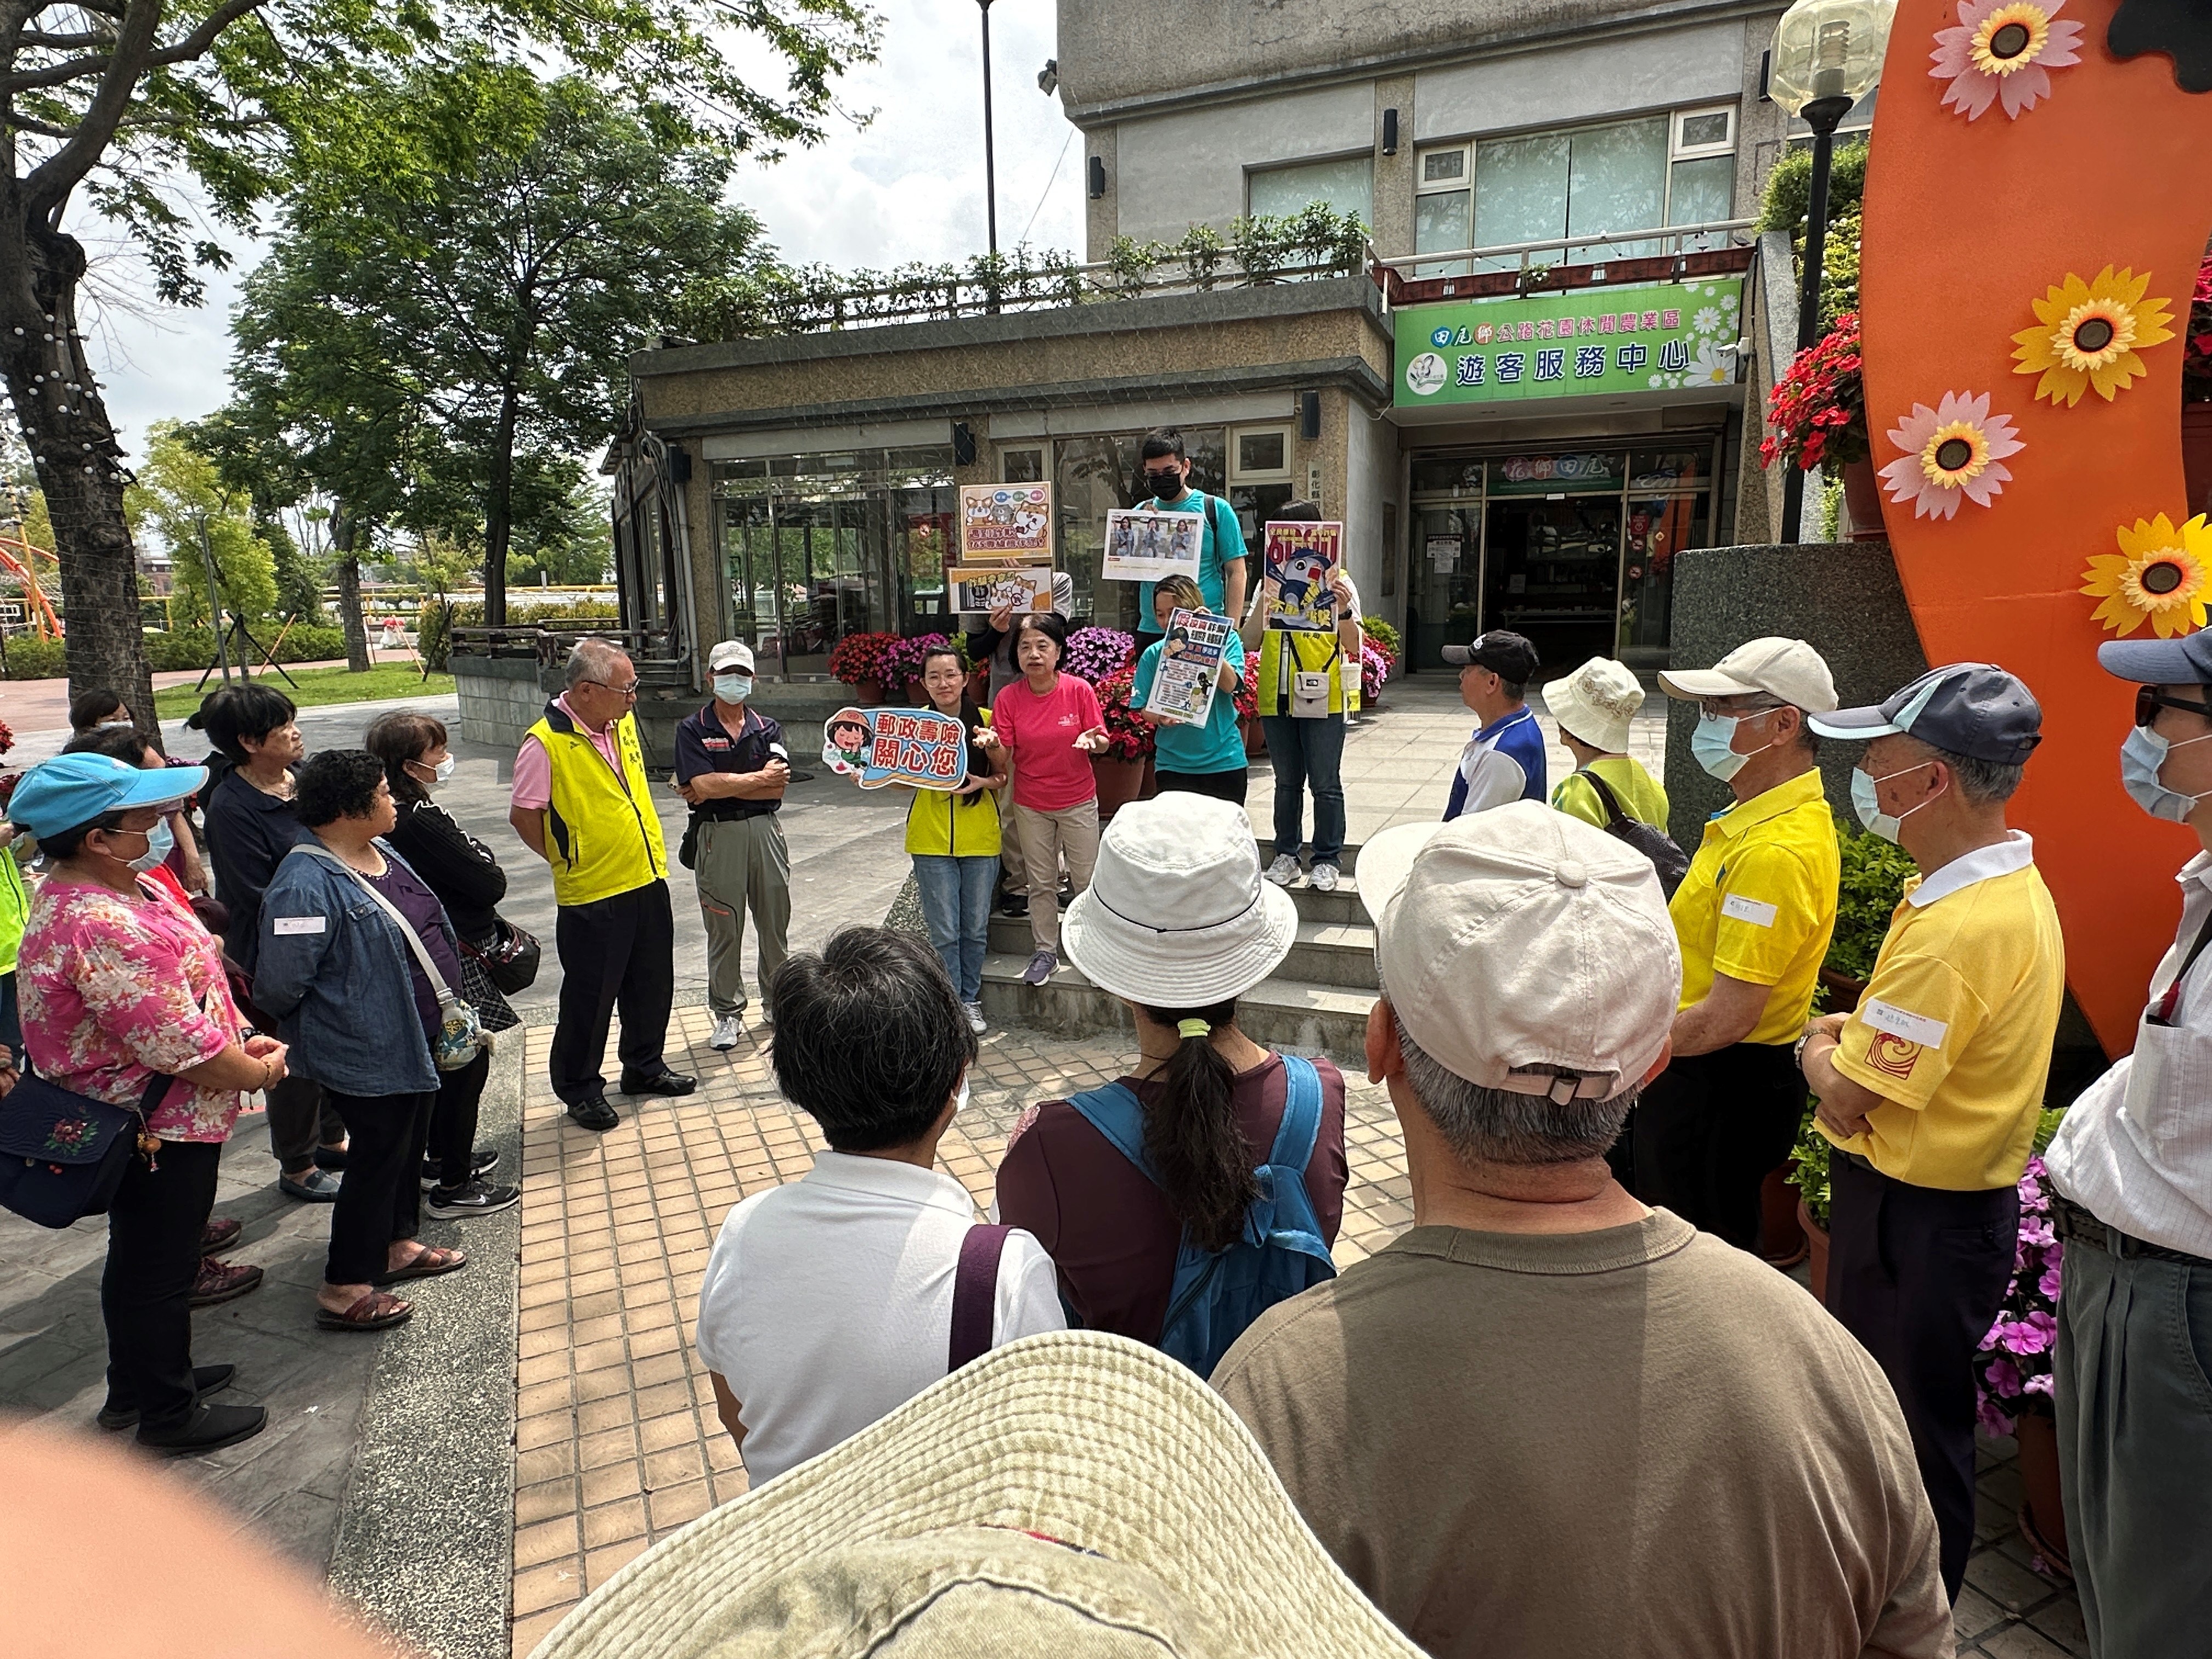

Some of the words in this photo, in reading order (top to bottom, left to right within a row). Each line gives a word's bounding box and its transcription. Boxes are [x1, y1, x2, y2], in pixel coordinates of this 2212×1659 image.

[1431, 309, 1681, 348] 田尾鄉公路花園休閒農業區
[1456, 338, 1690, 387] 遊客服務中心
[876, 714, 961, 746] 郵政壽險
[872, 738, 958, 776] 關心您
